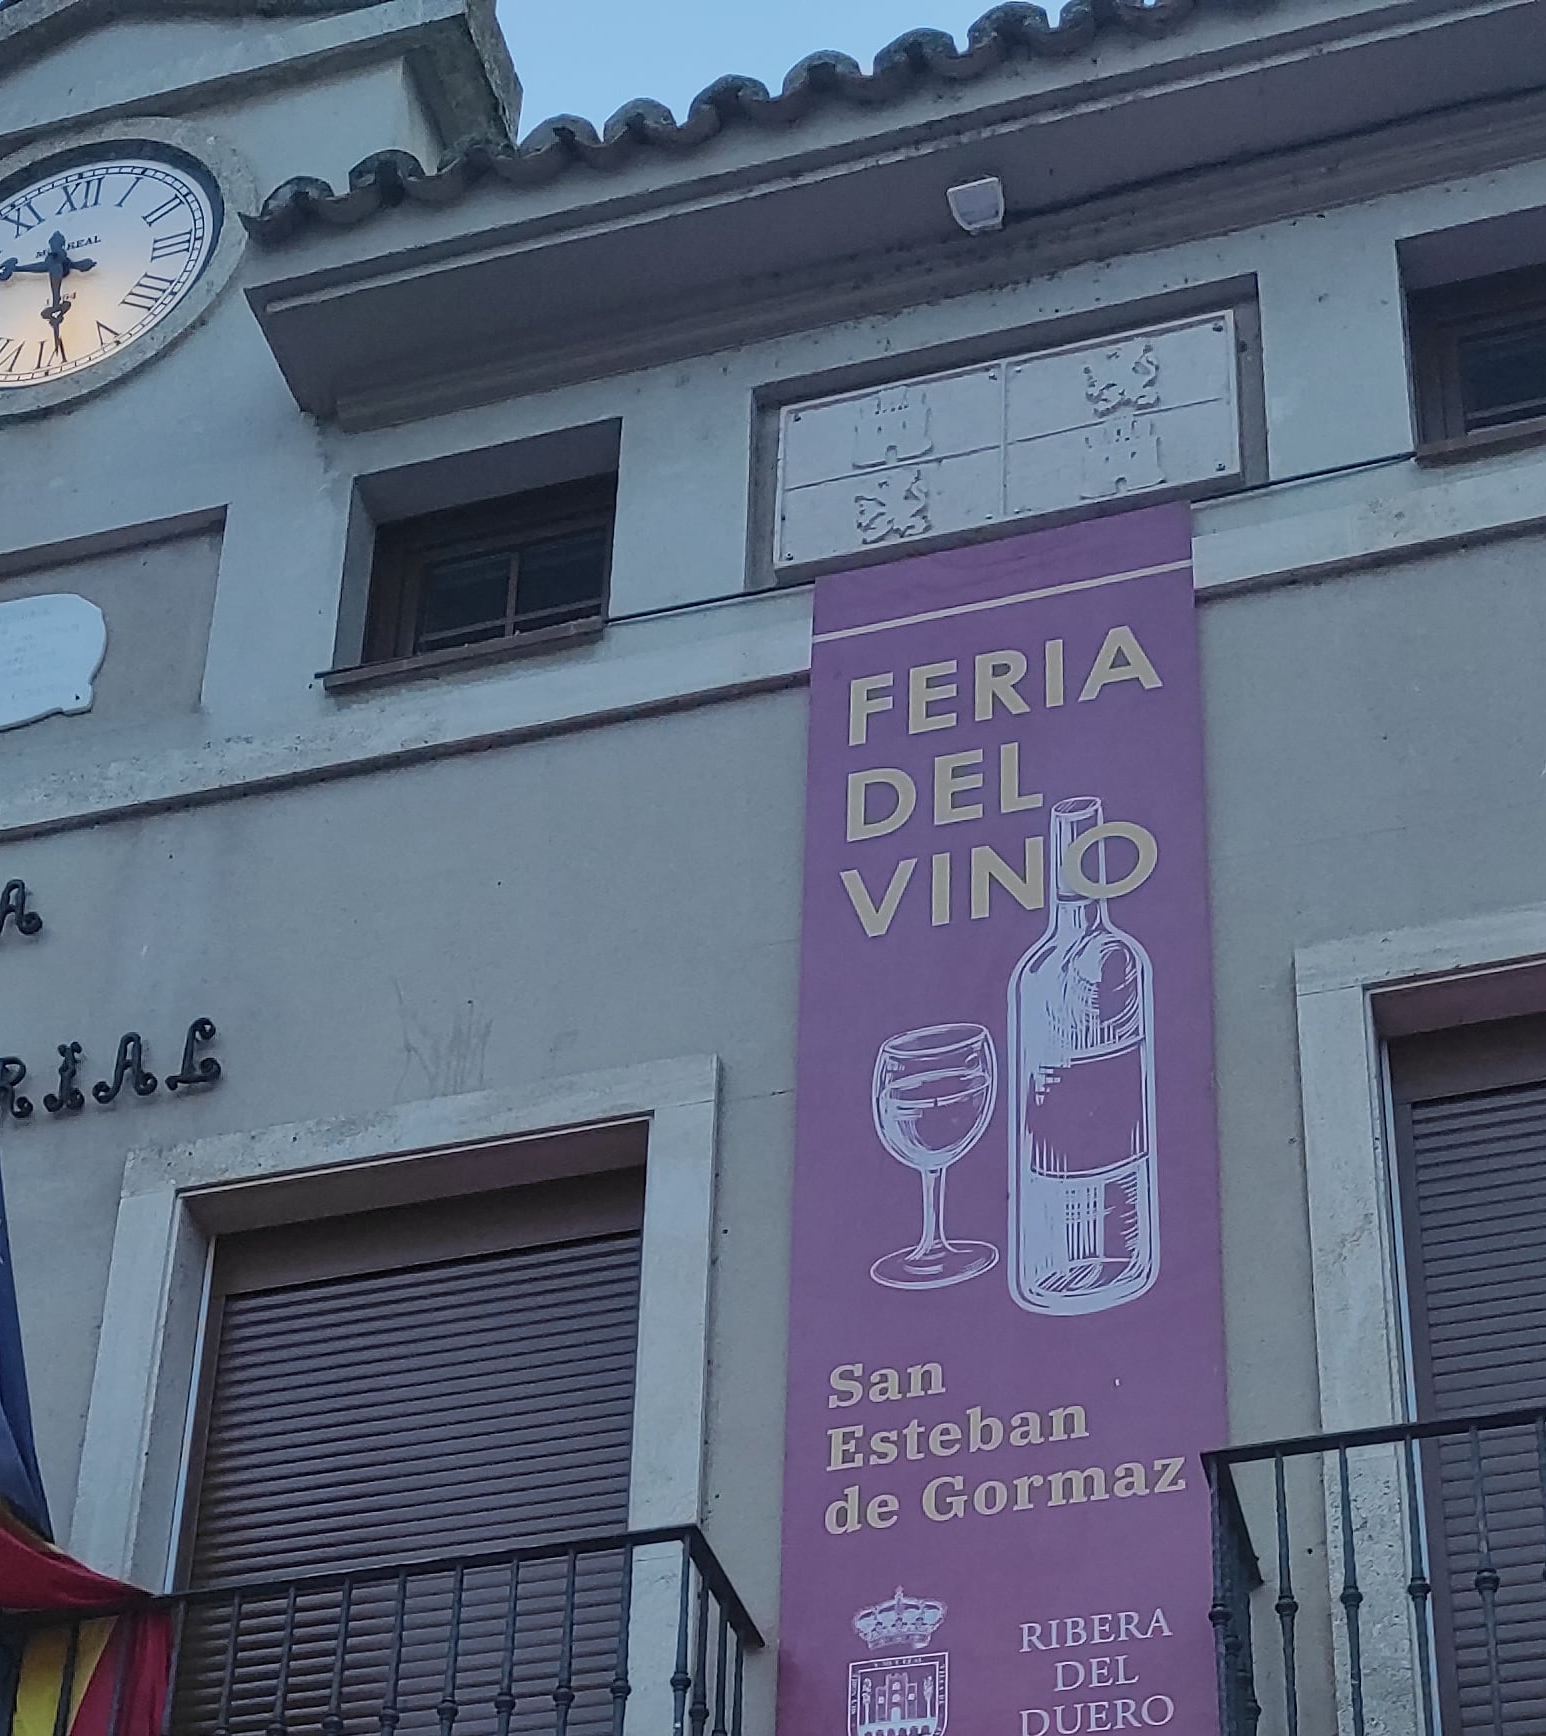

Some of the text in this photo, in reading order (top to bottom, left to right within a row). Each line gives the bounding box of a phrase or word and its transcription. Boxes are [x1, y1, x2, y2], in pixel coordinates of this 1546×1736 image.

[55, 176, 105, 215] XII
[141, 194, 185, 227] II
[1, 200, 45, 238] XI
[150, 229, 193, 263] III
[119, 272, 176, 311] IIII
[96, 320, 120, 346] V
[35, 336, 68, 370] VI
[848, 625, 1163, 746] FERIA
[847, 742, 1044, 842] DEL
[839, 821, 1159, 938] VINO
[828, 1360, 946, 1408] San
[826, 1403, 1090, 1471] Esteban
[824, 1456, 1187, 1534] de Gormaz
[1019, 1608, 1172, 1654] RIBERA
[1053, 1658, 1141, 1693] DEL
